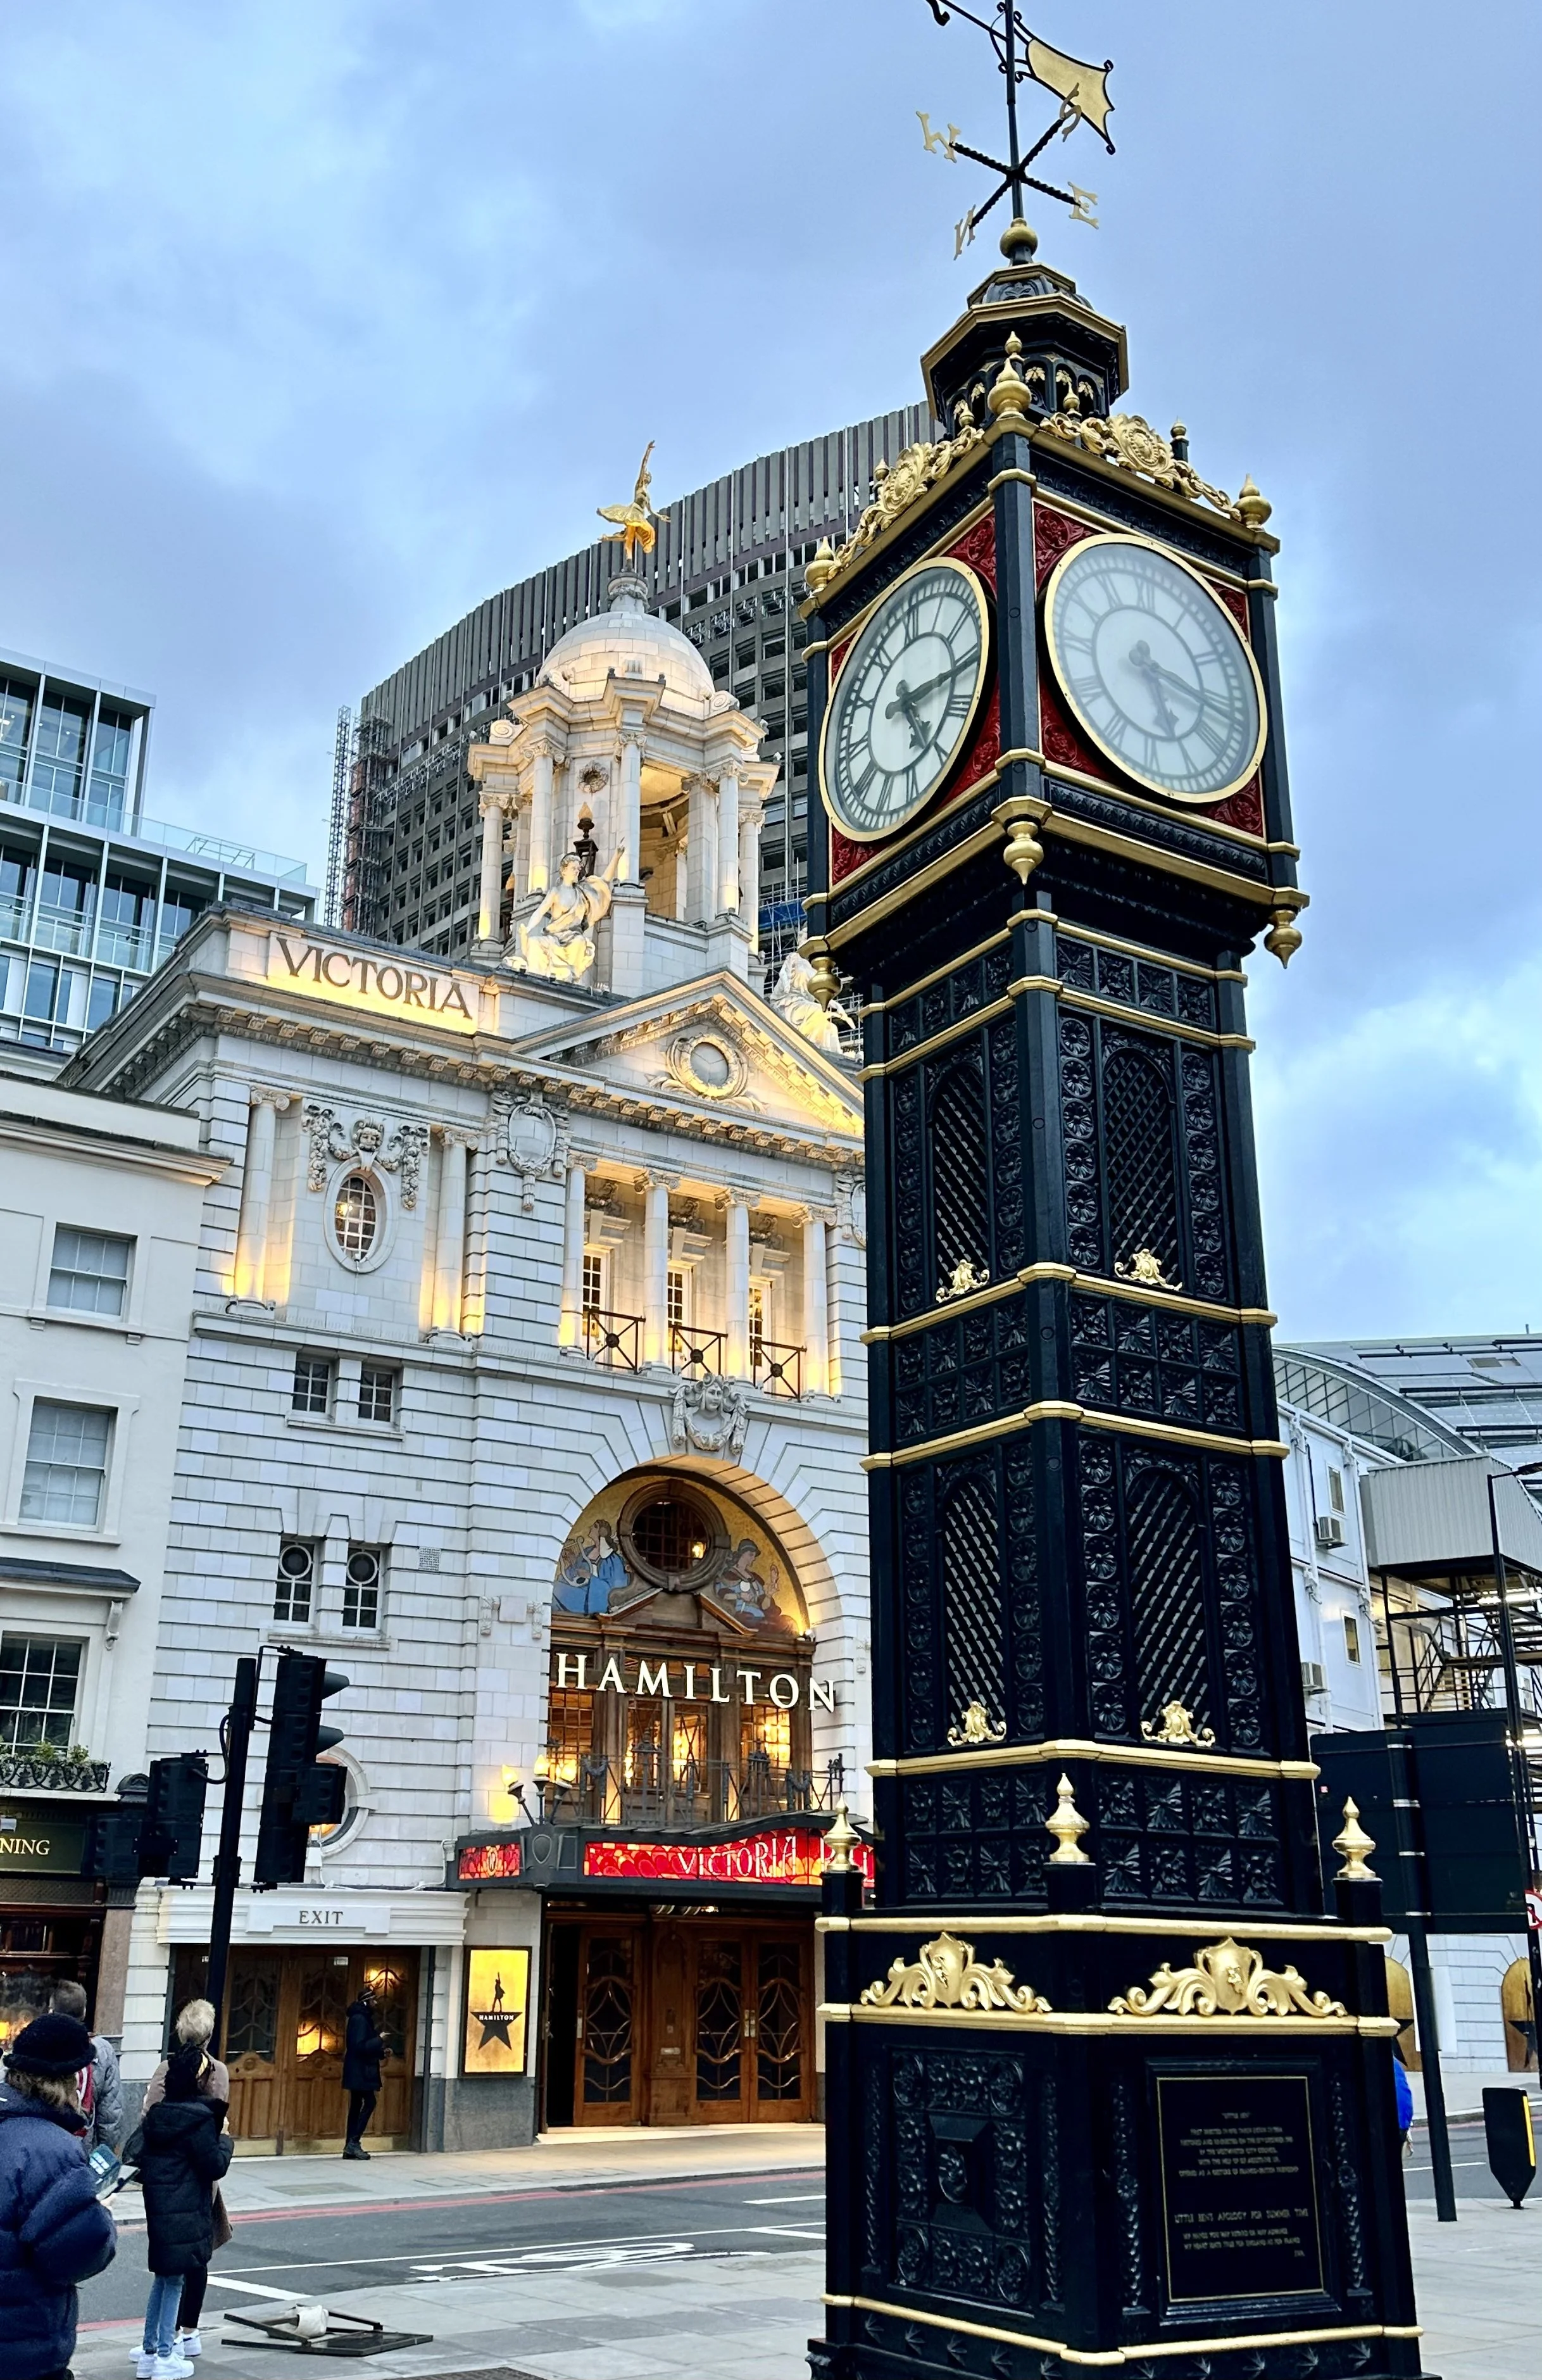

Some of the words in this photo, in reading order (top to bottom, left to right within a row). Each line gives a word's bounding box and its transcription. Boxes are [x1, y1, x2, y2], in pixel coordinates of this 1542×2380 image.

[1067, 181, 1100, 230] E
[276, 937, 473, 1020] VICTORIA
[555, 1653, 836, 1713] HAMILTON
[677, 1836, 797, 1878] VICTORIA
[299, 1910, 344, 1925] EXIT
